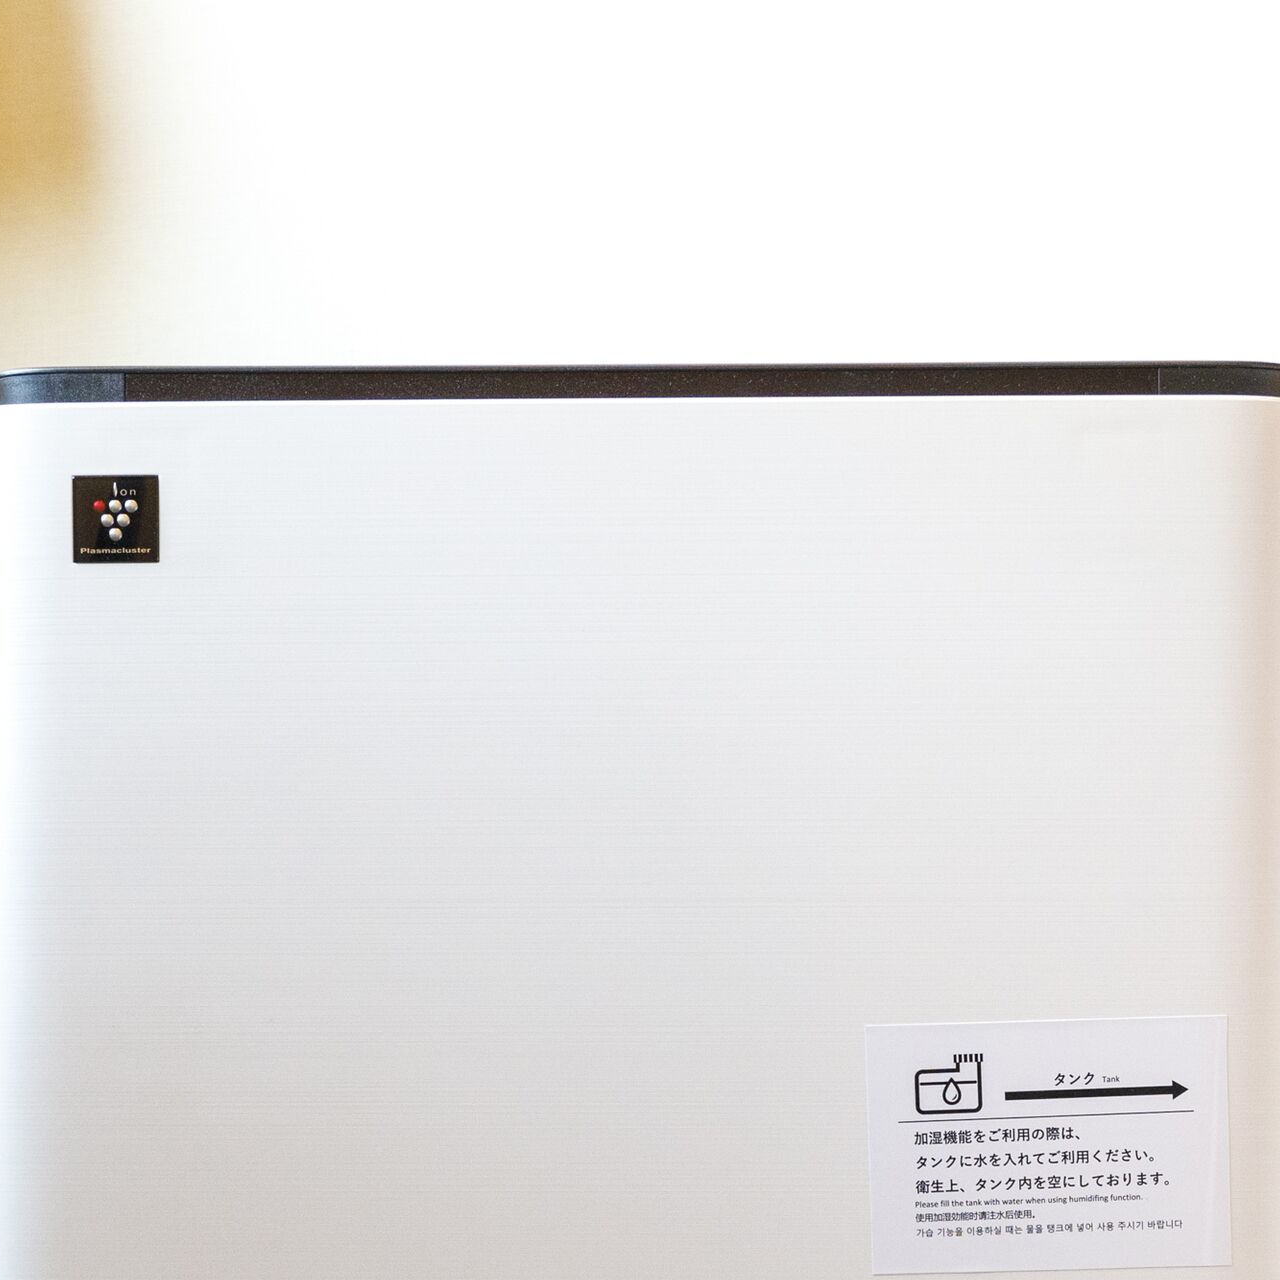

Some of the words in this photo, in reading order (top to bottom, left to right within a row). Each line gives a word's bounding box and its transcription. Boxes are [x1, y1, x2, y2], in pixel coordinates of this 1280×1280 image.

[113, 482, 136, 497] Ion
[1053, 1072, 1095, 1087] タンク
[1102, 1074, 1120, 1084] Tank
[914, 1127, 1081, 1145] 加湿機能をご利用の際は、
[916, 1148, 1156, 1169] タンクに水を入れてご利用ください。
[915, 1171, 1170, 1194] 衛生上、タンク内を空にしております。
[1069, 1194, 1108, 1203] humidifing
[917, 1228, 933, 1237] 가습
[937, 1227, 963, 1237] 기능을
[967, 1226, 1001, 1236] 이용하실
[1006, 1226, 1023, 1234] 때는
[1047, 1224, 1073, 1232] 탱크에
[1077, 1223, 1093, 1232] 넣어
[1097, 1222, 1114, 1231] 사용
[1118, 1221, 1144, 1230] 주시기
[1148, 1220, 1183, 1229] 바랍니다
